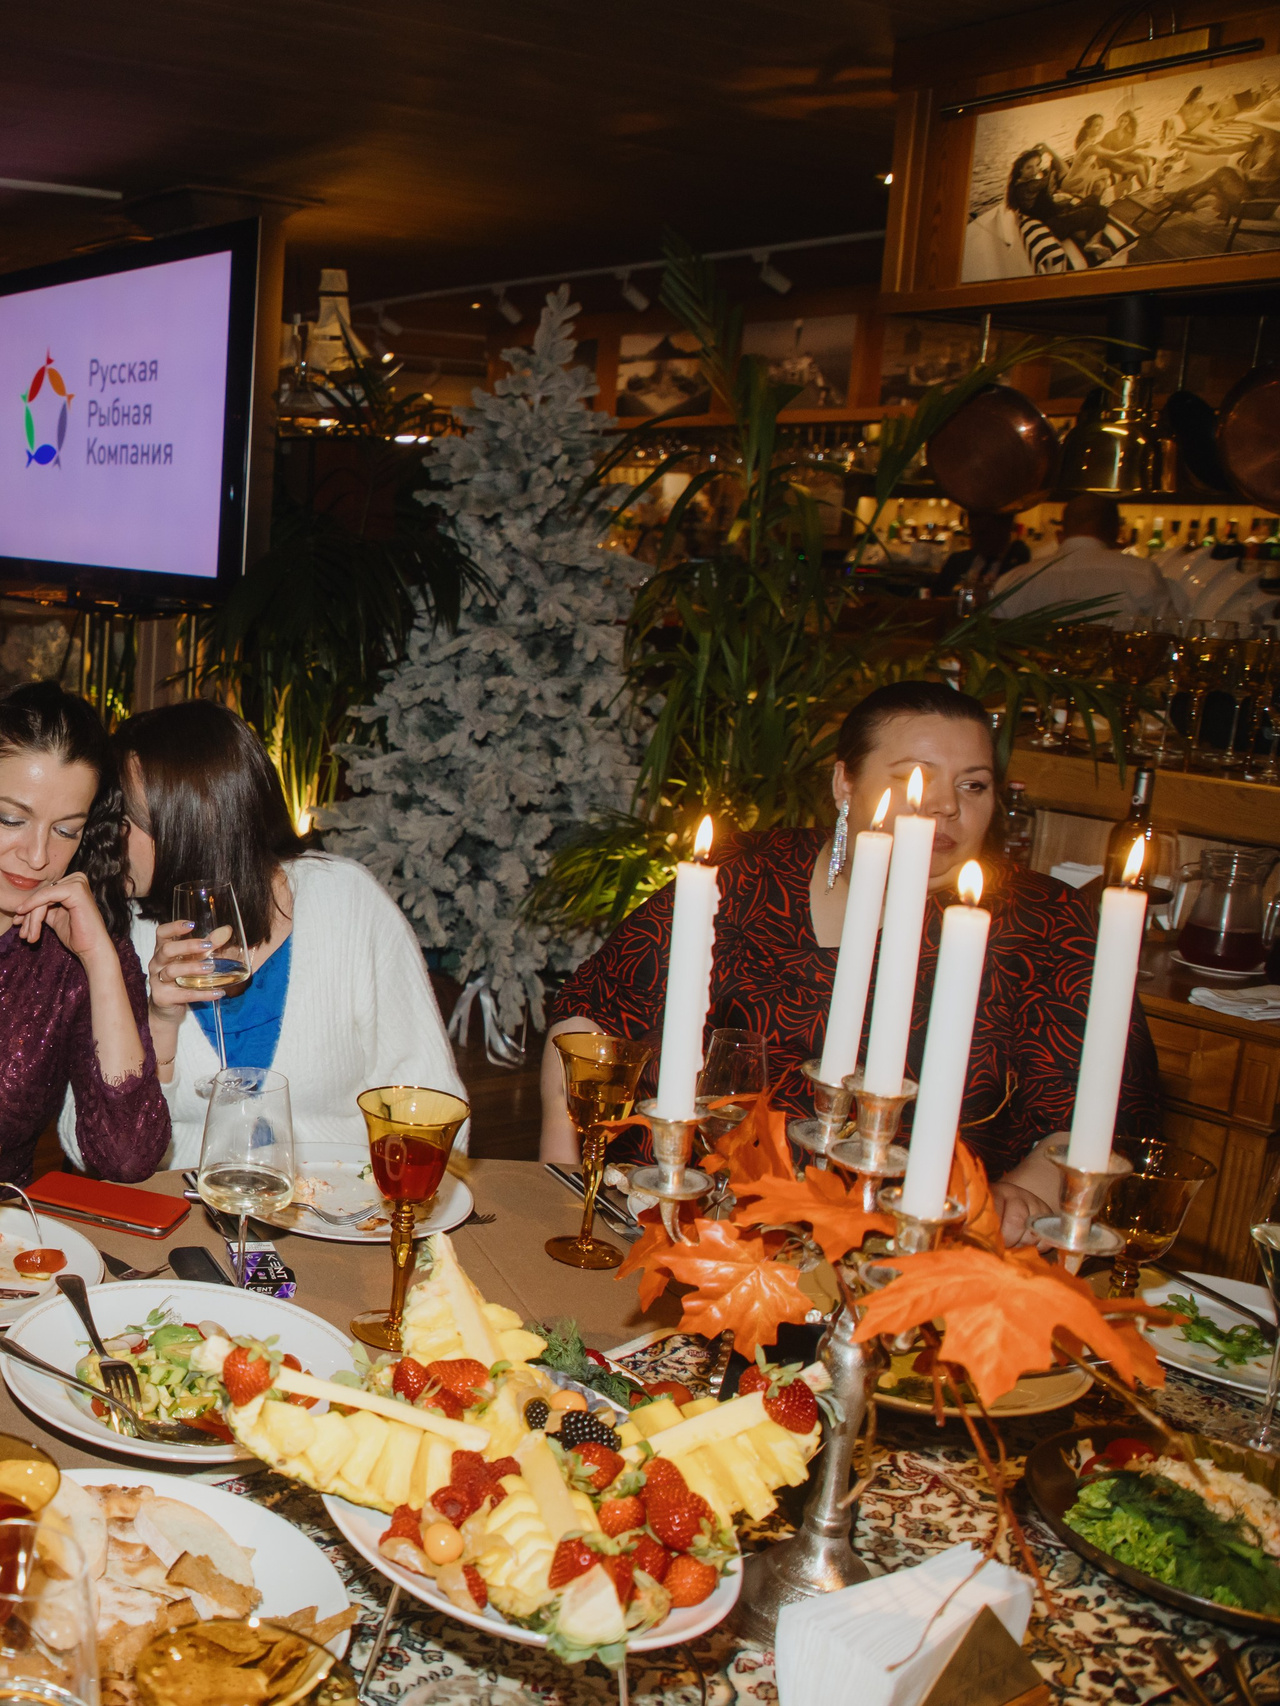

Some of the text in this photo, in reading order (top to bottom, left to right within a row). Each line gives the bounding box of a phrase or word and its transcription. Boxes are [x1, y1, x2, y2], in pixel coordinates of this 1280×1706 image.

[88, 357, 158, 393] Русская
[87, 397, 152, 428] Рыбная
[86, 437, 173, 465] Компания
[265, 1254, 288, 1279] KENT
